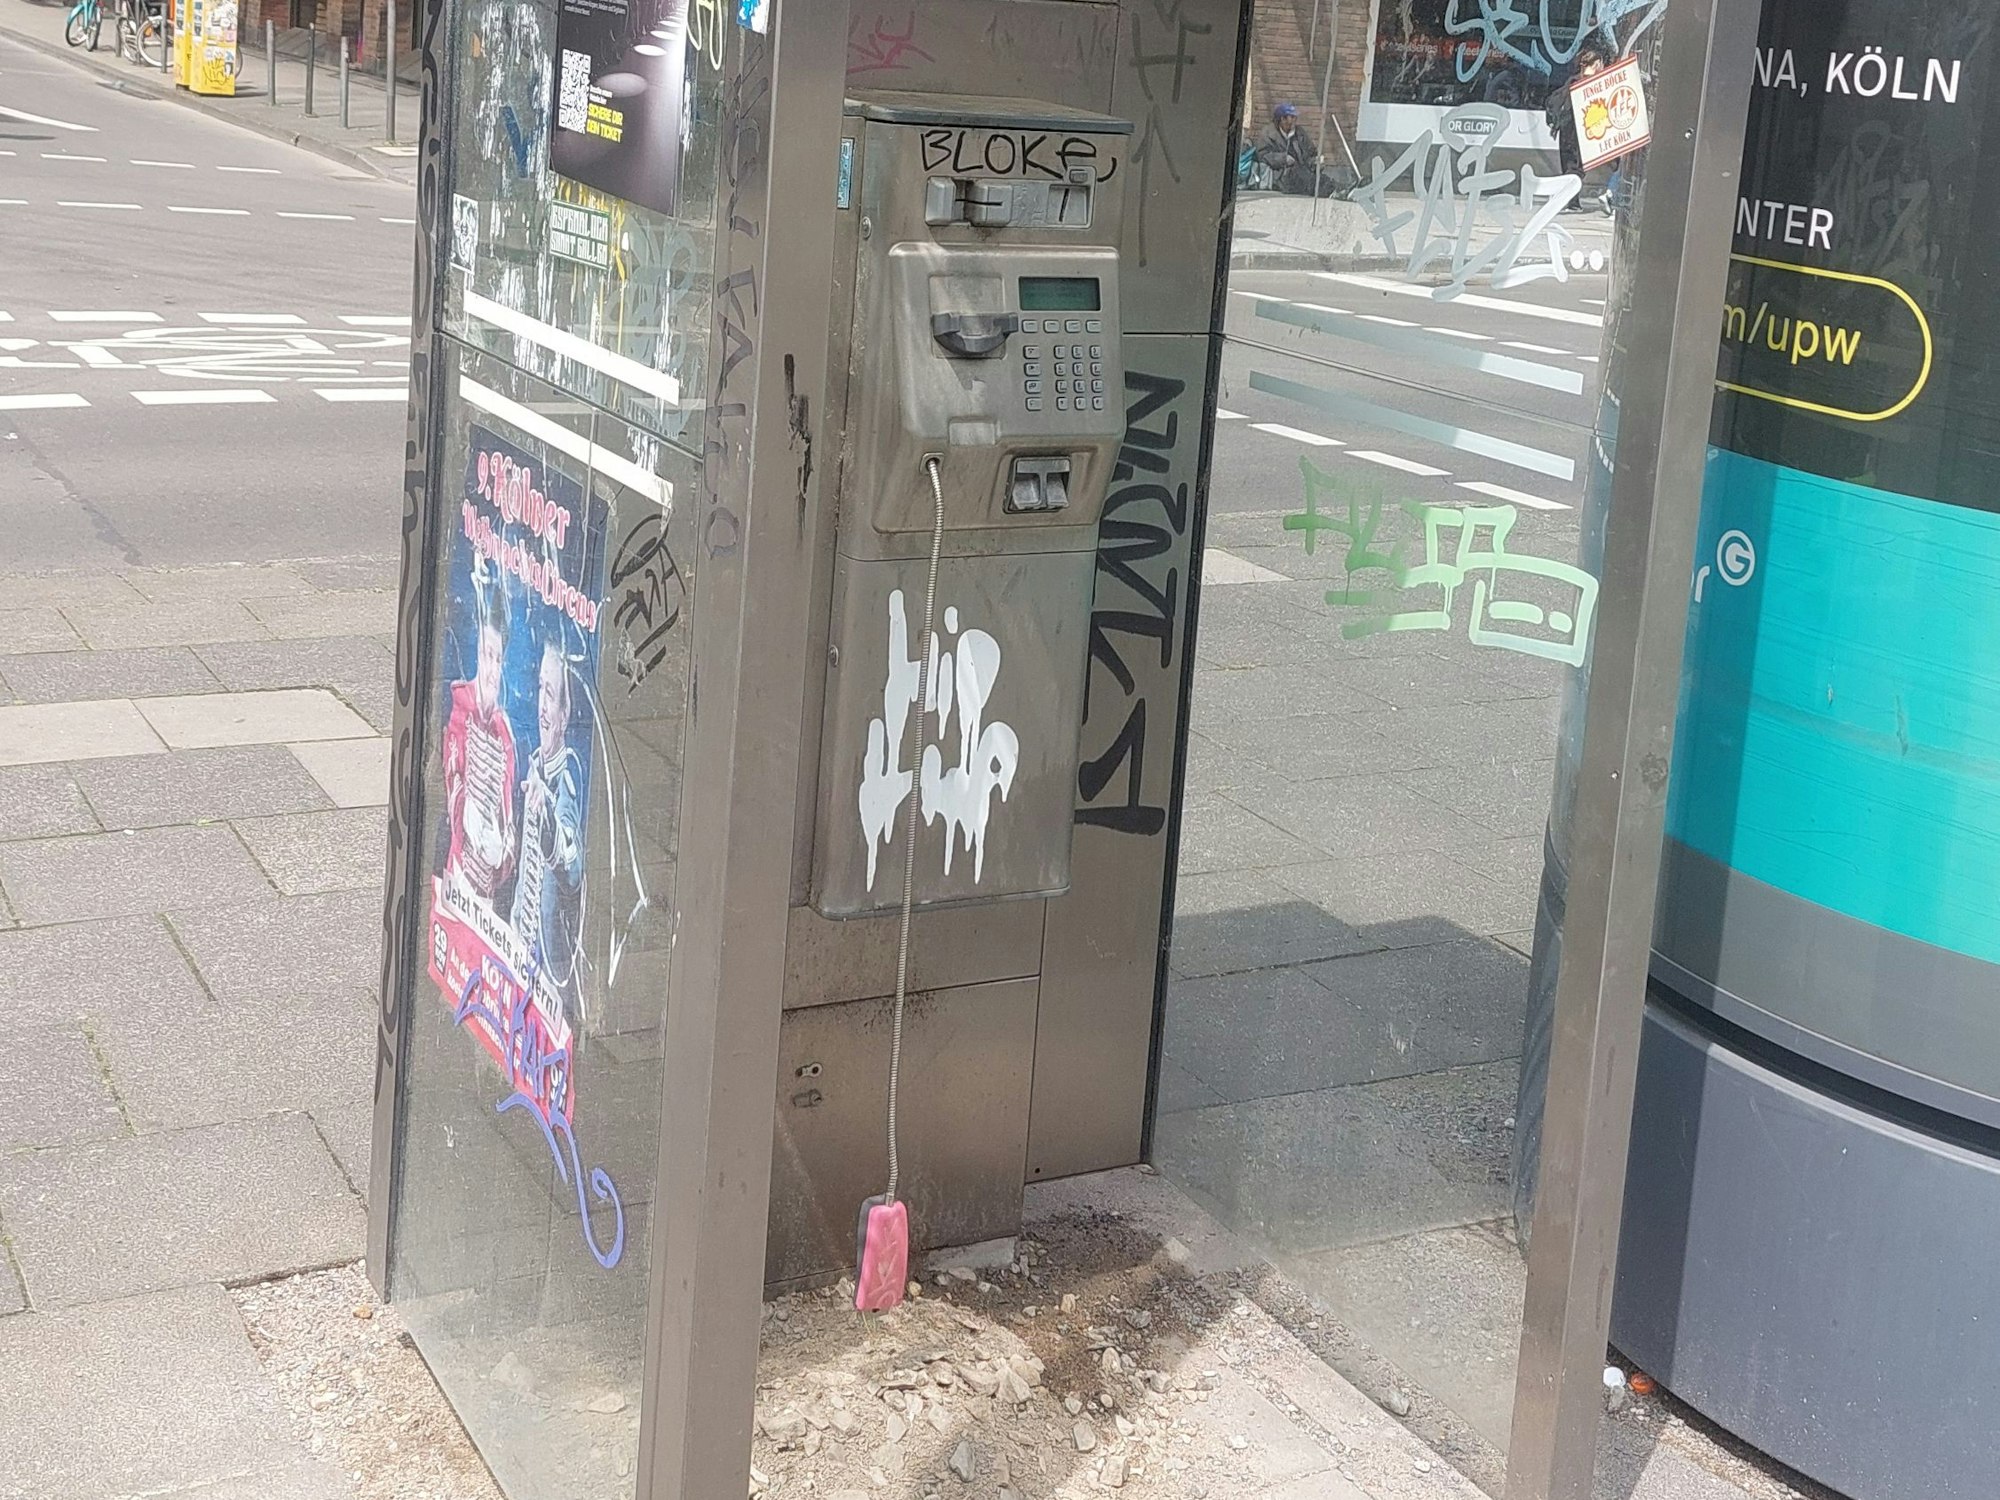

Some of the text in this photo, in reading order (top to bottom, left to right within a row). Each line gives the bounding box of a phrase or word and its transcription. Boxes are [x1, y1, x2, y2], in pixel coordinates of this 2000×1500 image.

[1583, 70, 1628, 101] JUNGE BÖCKE
[1825, 46, 1961, 104] KÖLN
[600, 122, 623, 143] TICKET
[1463, 121, 1496, 132] GLORY
[1614, 129, 1632, 146] KÖLN
[1736, 197, 1834, 250] NTER
[490, 451, 571, 549] Kölner
[446, 879, 471, 918] Jetzt
[472, 901, 512, 959] Tickets
[434, 922, 448, 955] 29
